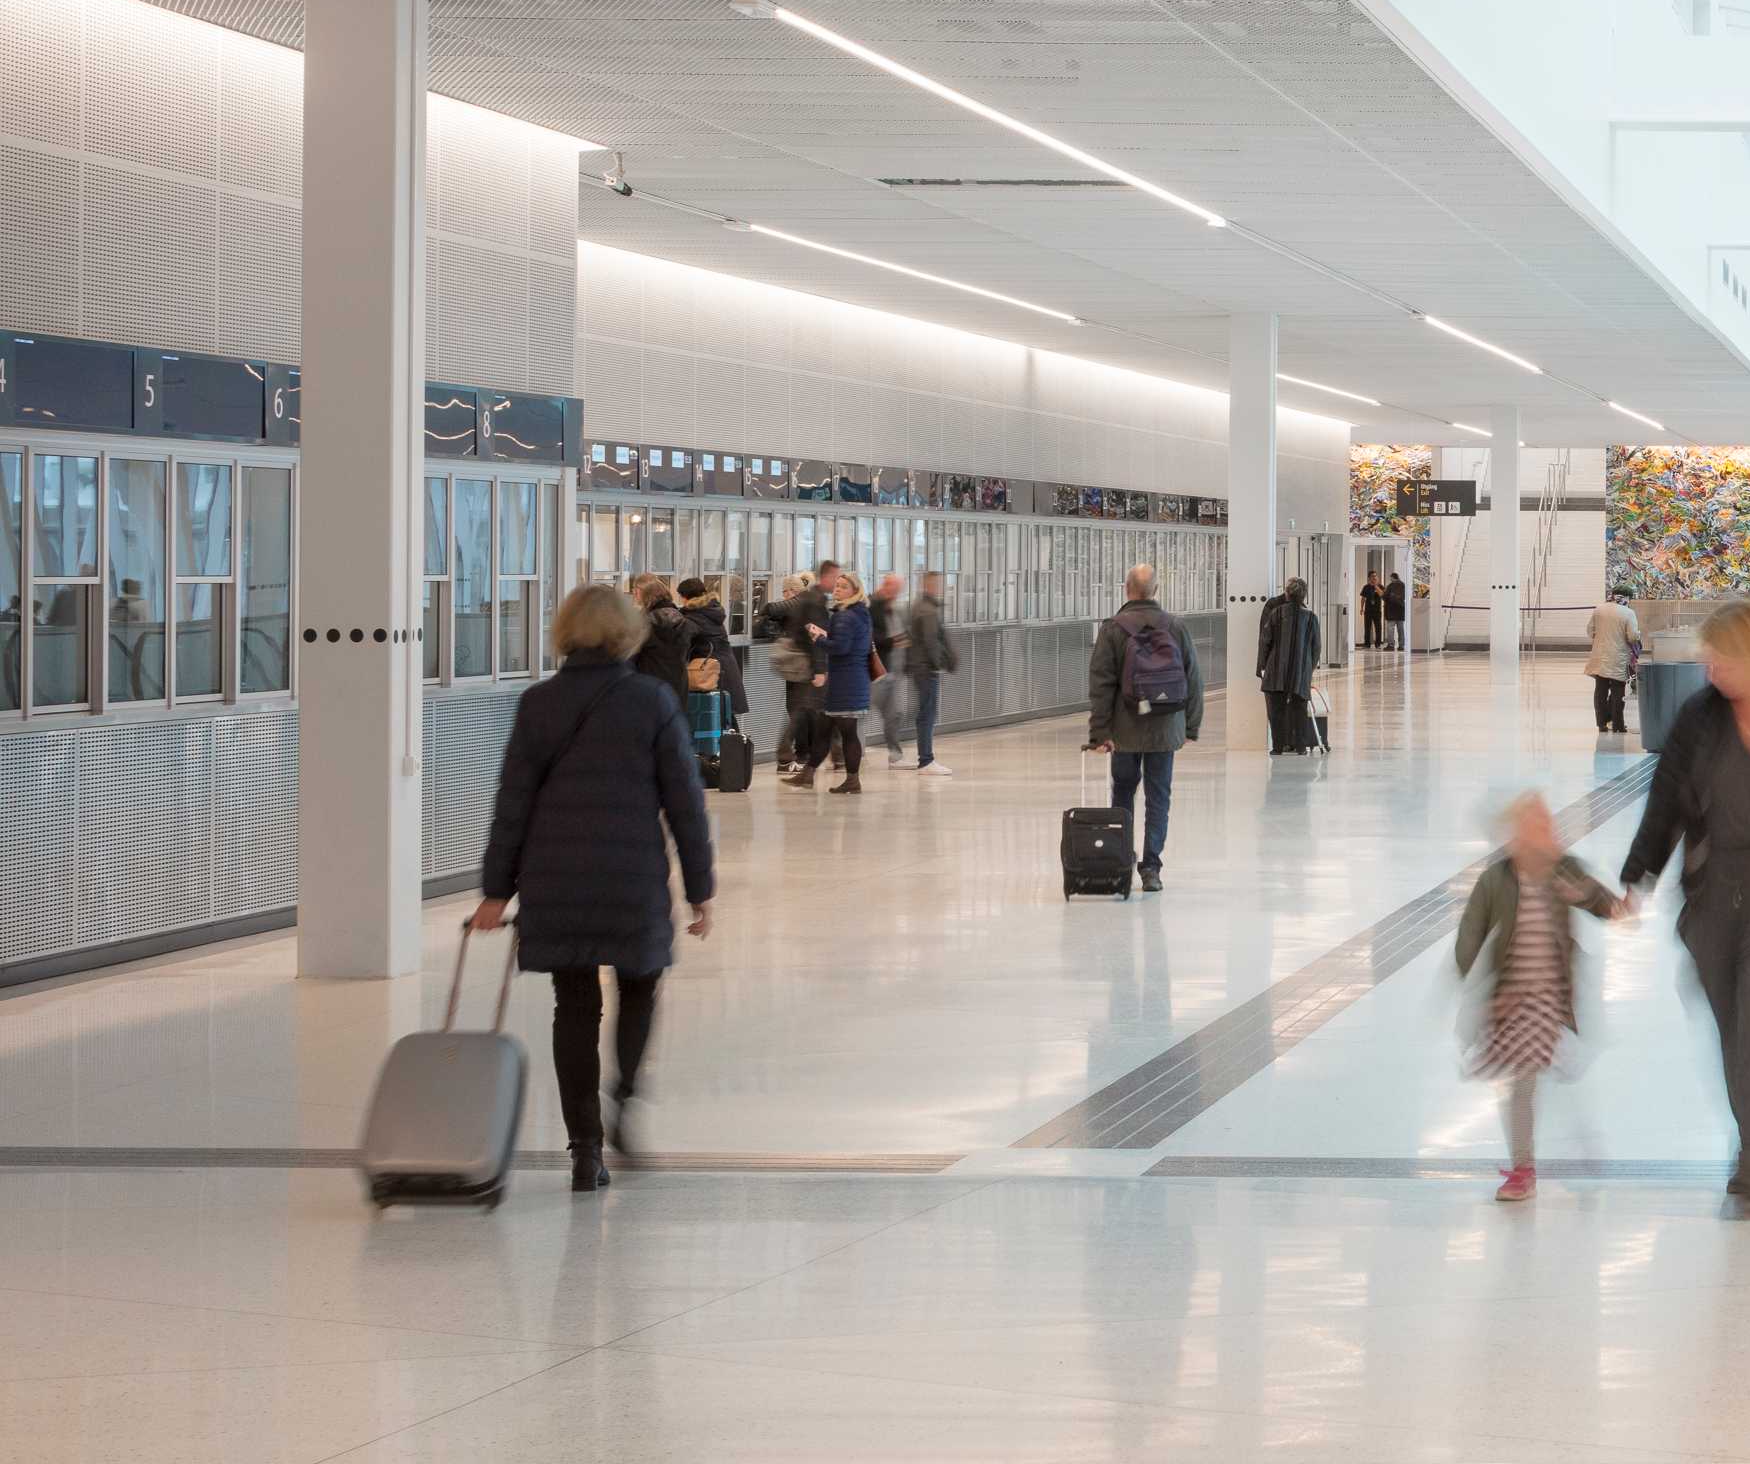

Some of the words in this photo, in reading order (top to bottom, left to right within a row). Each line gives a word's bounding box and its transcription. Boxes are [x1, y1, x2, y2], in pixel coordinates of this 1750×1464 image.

[144, 374, 155, 408] 5
[274, 387, 284, 418] 6
[483, 410, 491, 438] 8
[584, 455, 592, 474] 12
[641, 458, 649, 478] 13
[745, 467, 752, 485] 15
